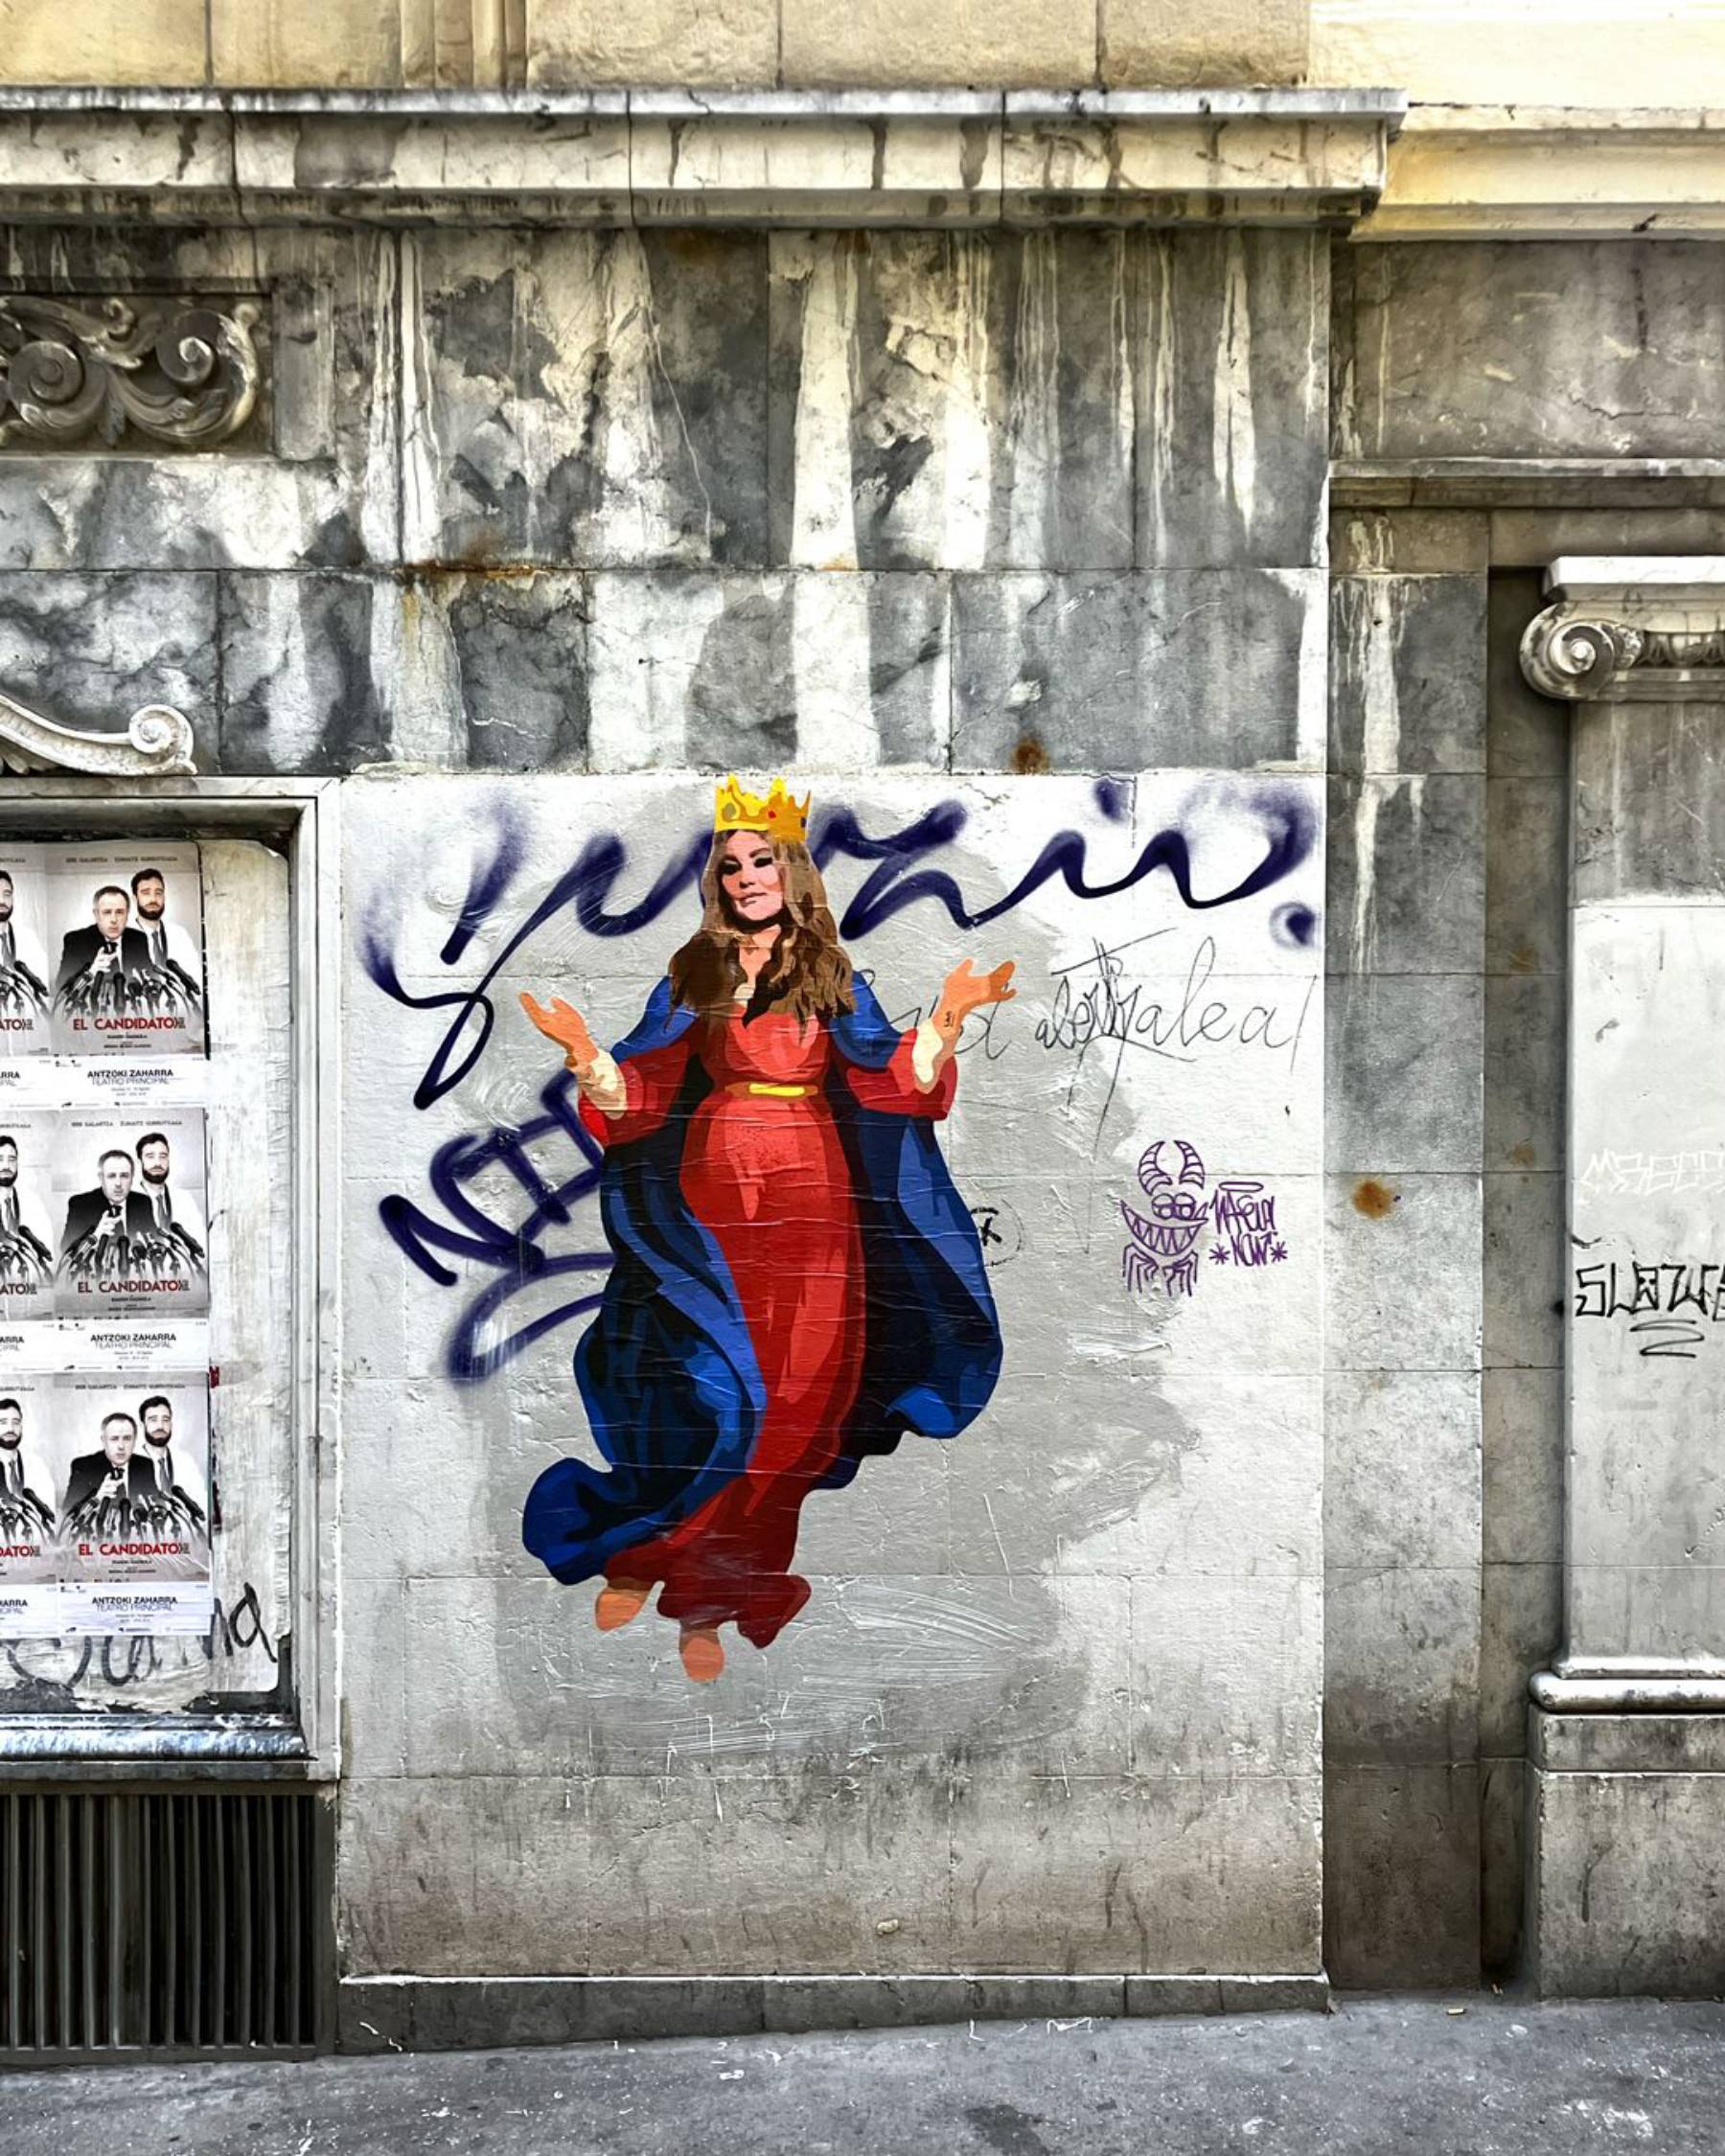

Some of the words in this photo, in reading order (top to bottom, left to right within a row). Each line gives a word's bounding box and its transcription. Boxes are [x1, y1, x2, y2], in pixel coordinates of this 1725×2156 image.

[73, 1019, 87, 1030] EL
[95, 1017, 175, 1030] CANDIDATO
[78, 1281, 92, 1294] EL
[99, 1280, 179, 1293] CANDIDATO
[79, 1544, 93, 1556] EL
[99, 1543, 179, 1555] CANDIDATO
